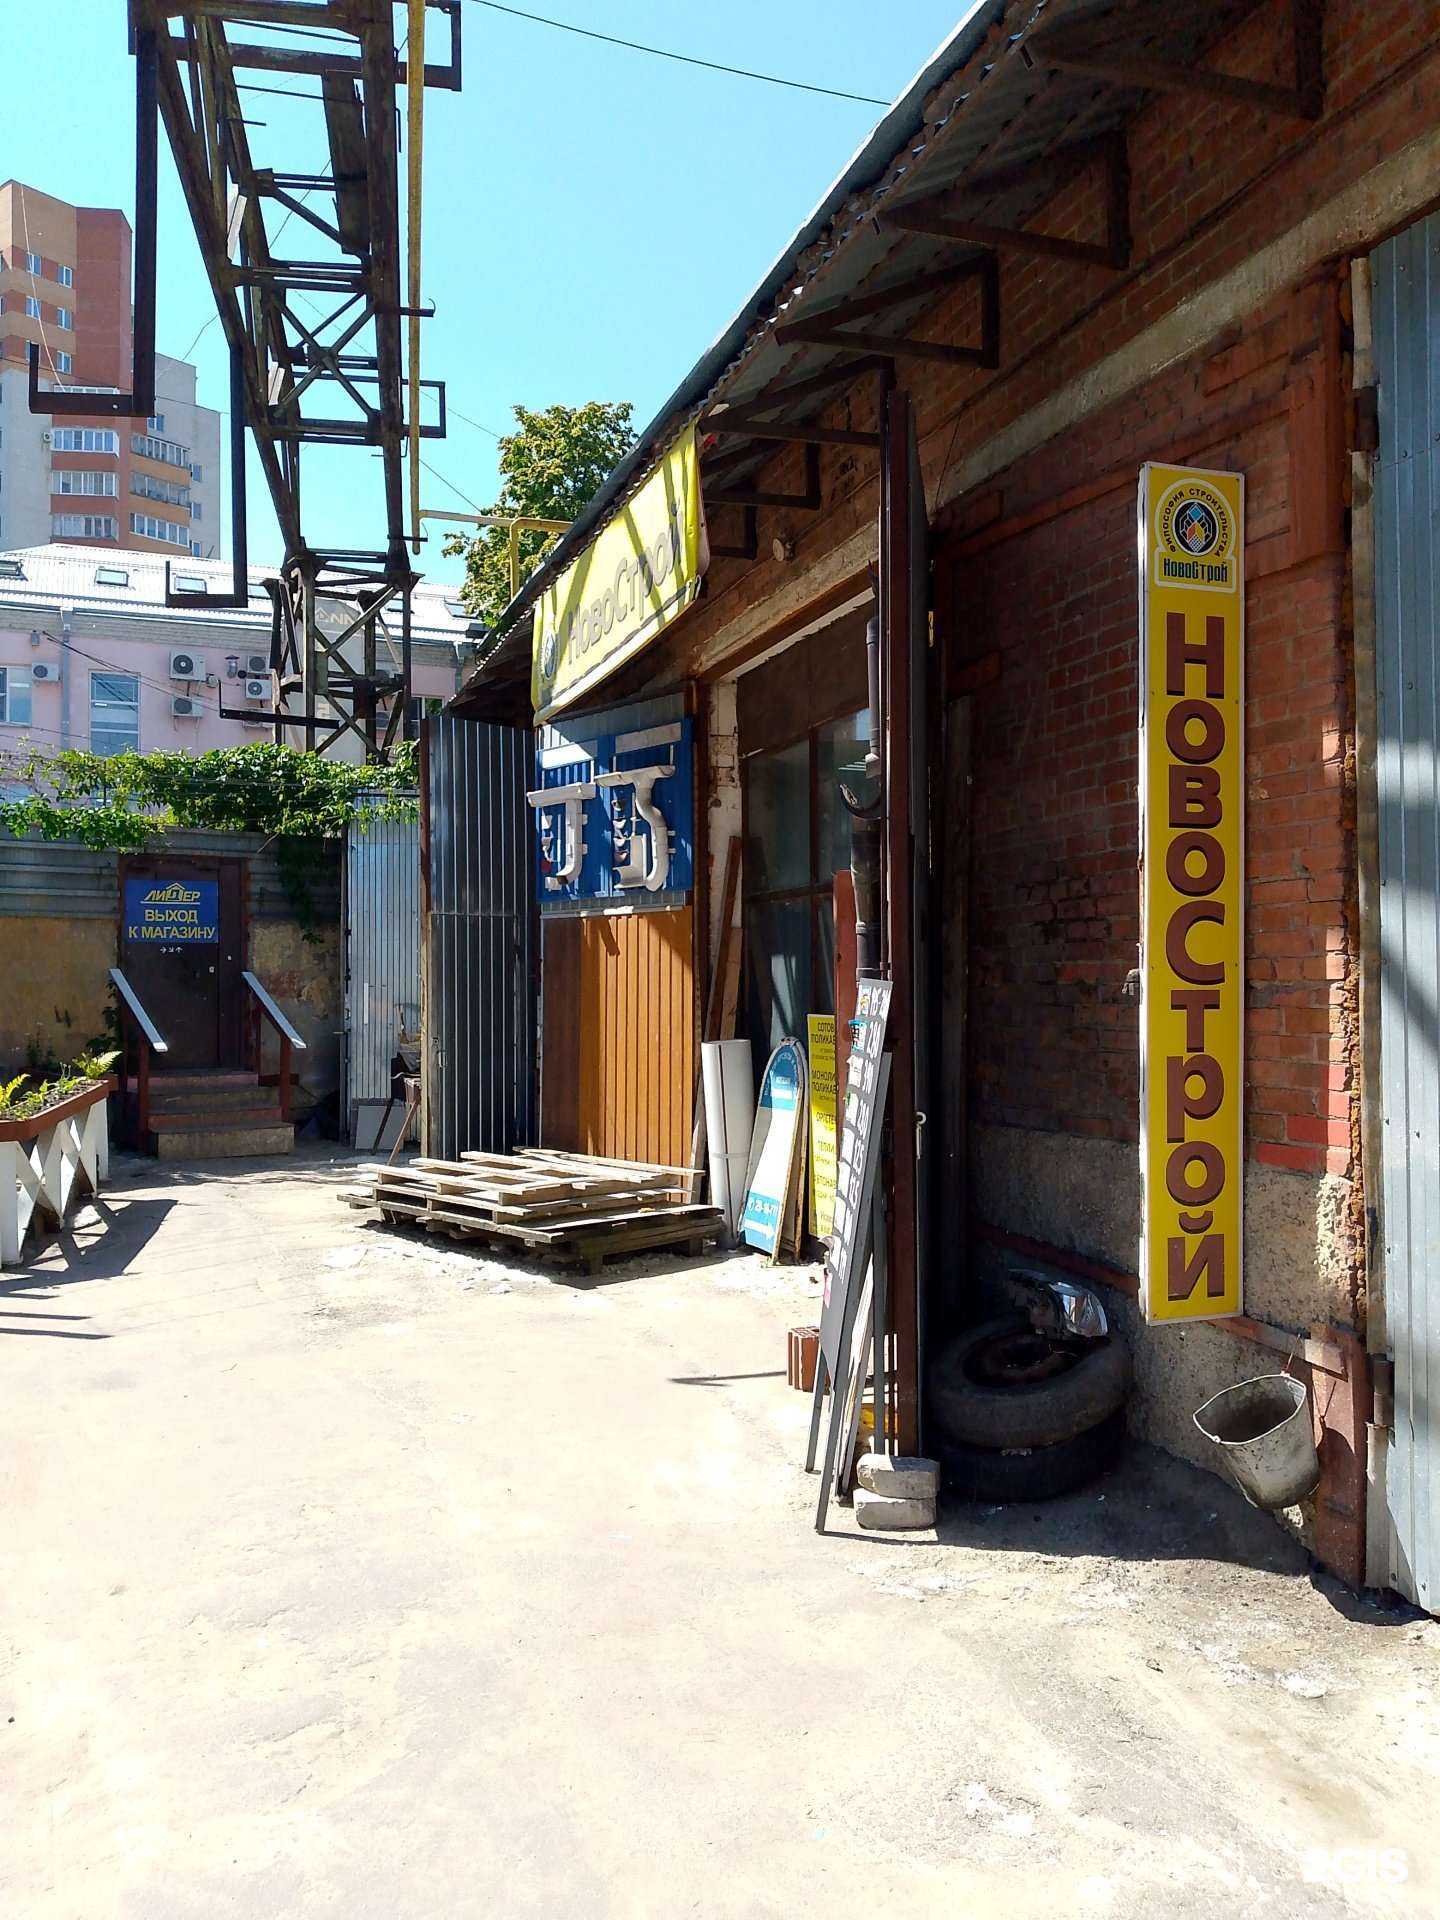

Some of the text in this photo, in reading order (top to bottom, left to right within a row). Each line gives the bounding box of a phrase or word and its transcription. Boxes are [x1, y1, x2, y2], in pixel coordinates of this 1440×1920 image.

[1162, 488, 1228, 557] ФИЛОСОФИЯ СТРОИТЕЛЬСТВА
[1163, 558, 1228, 583] НовоСтрой
[143, 884, 201, 902] ЛИДЕР
[144, 909, 198, 924] ВЫХОД
[128, 926, 215, 939] К МАГАЗИНУ
